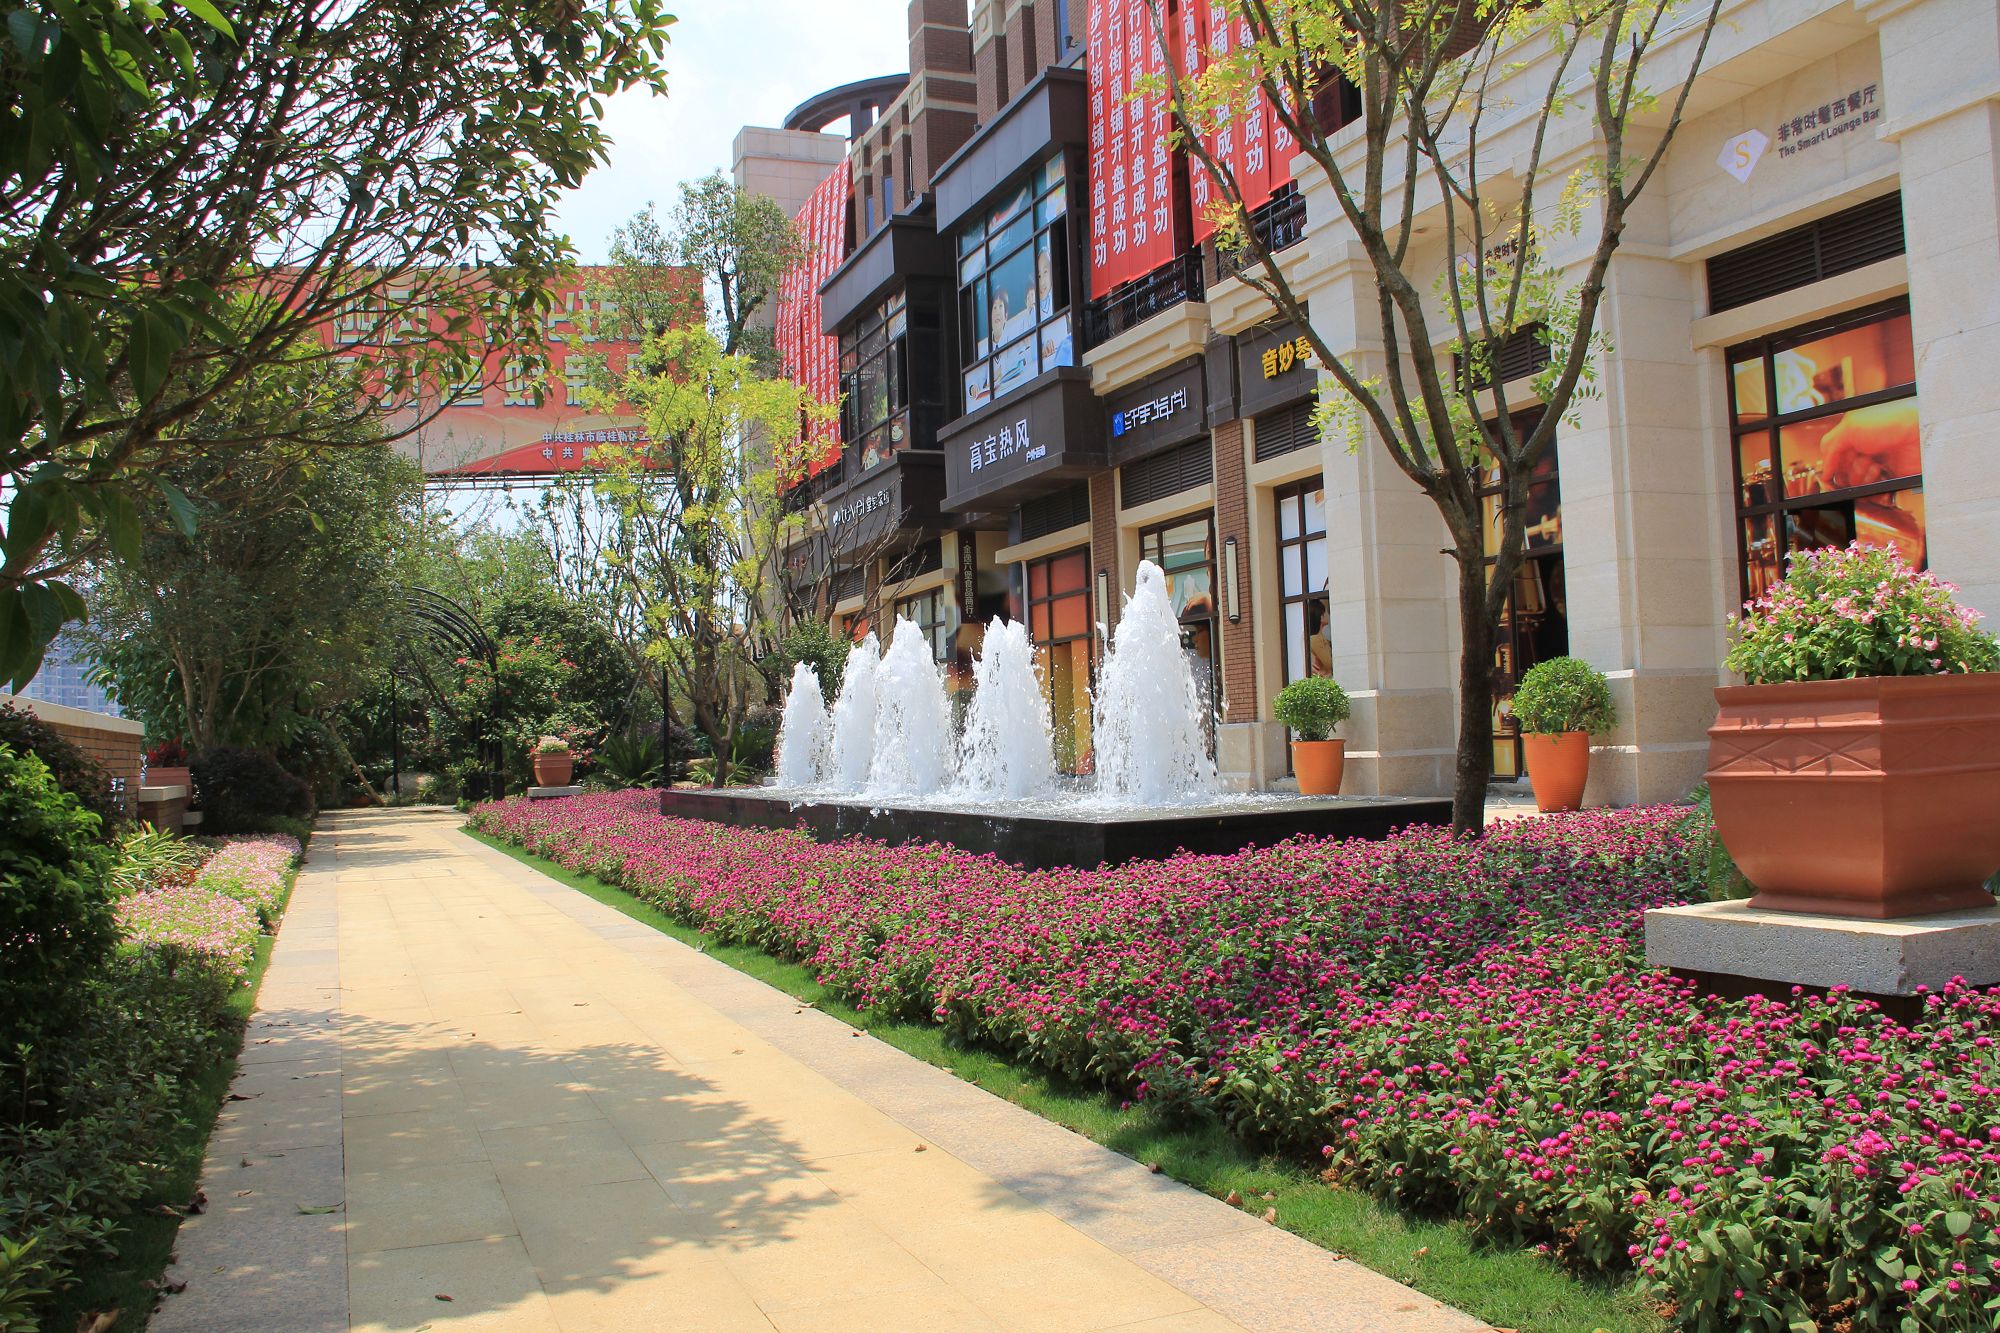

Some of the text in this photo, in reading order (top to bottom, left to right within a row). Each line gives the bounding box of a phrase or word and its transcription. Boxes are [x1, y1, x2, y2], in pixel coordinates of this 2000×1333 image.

[1779, 107, 1880, 159] The Smart Lounge Bar
[969, 418, 1031, 474] 高宝热风
